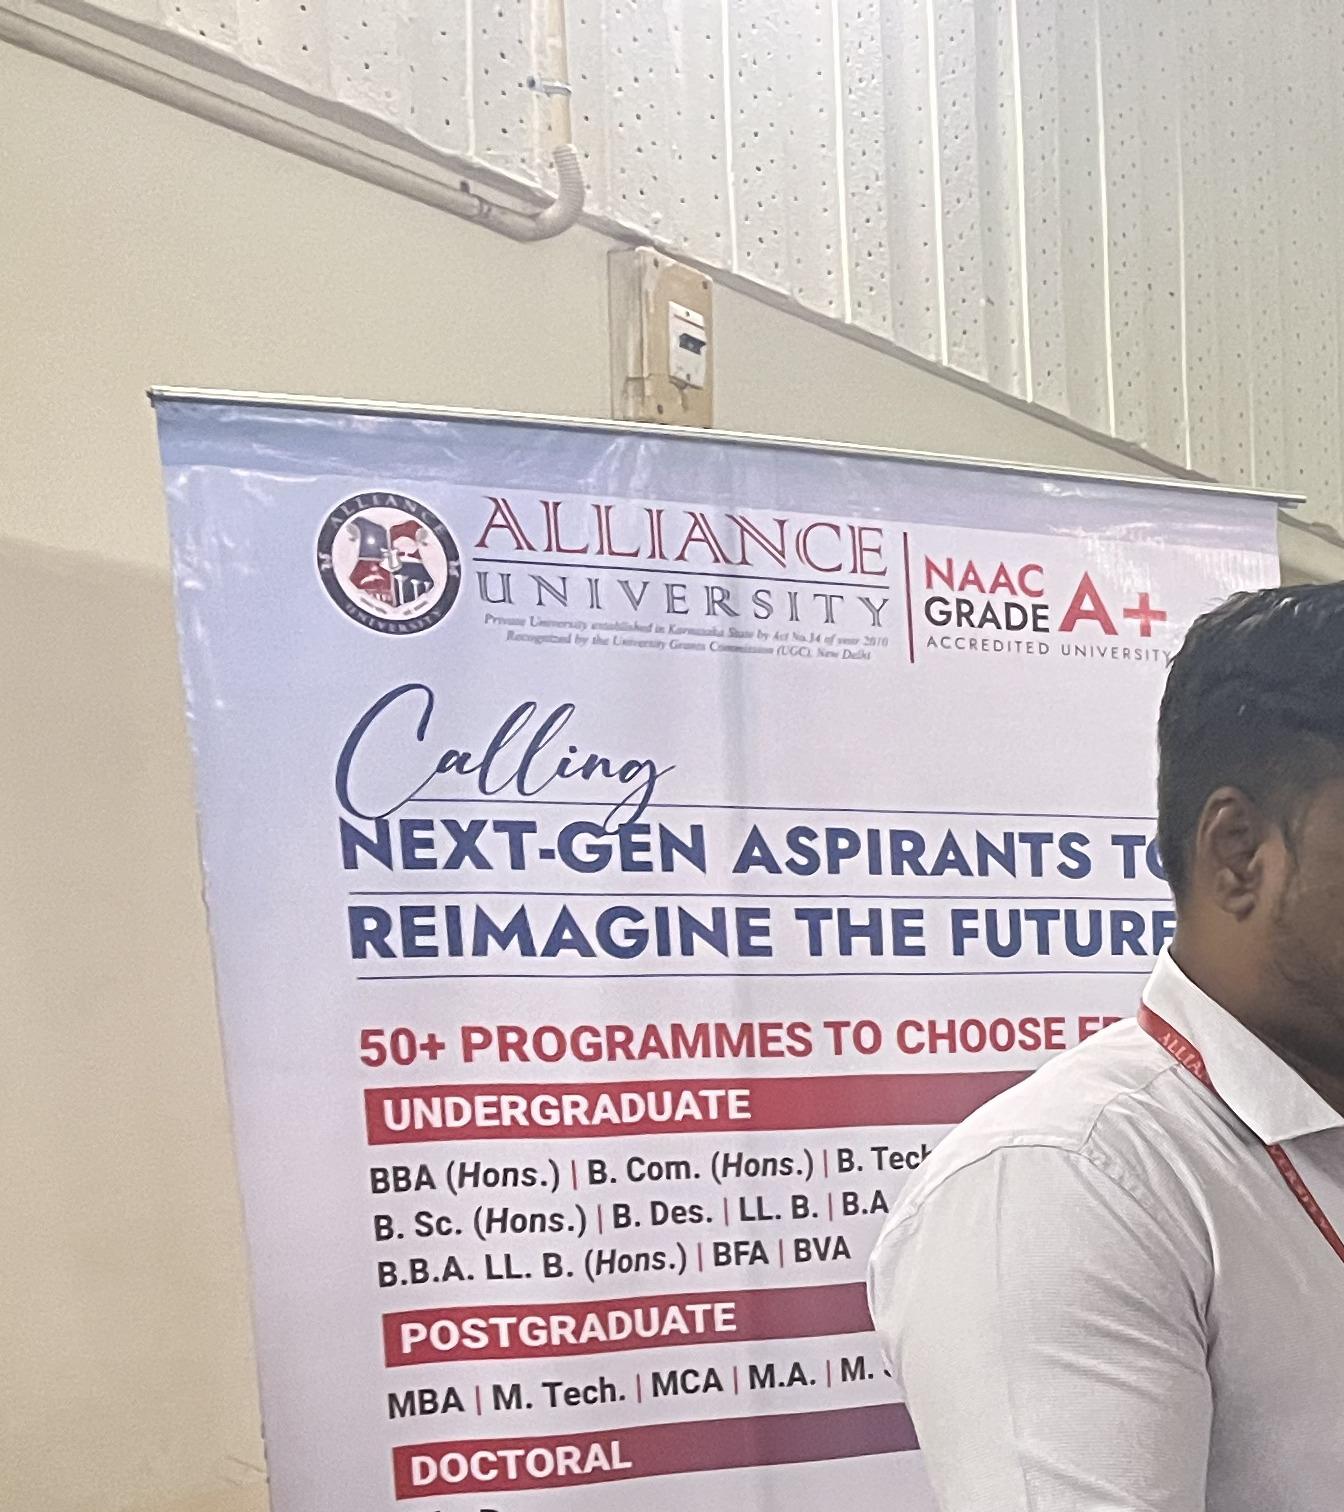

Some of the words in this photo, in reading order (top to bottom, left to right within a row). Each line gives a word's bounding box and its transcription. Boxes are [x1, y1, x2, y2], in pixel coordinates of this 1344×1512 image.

[474, 496, 888, 577] ALLIANCE
[476, 570, 889, 628] UNIVERSITY
[924, 555, 1043, 598] NAAC
[924, 596, 1050, 633] GRADE
[1058, 571, 1167, 637] A+
[927, 635, 1049, 656] ACCREDITED
[1061, 644, 1172, 663] UNIVERSITY
[335, 683, 677, 836] Calling
[339, 816, 707, 876] NEXT-GEN
[732, 824, 1092, 880] ASPIRANTS
[347, 904, 773, 960] REIMAGINE
[794, 906, 926, 957] THE
[951, 908, 1177, 959] FUTURE
[360, 1027, 446, 1068] 50+
[461, 1021, 813, 1063] PROGRAMMES
[824, 1020, 883, 1056] TO
[896, 1017, 1067, 1055] CHOOSE
[383, 1089, 752, 1132] UNDERGRADUATE
[369, 1163, 437, 1194] BBA
[446, 1157, 560, 1197] (Hons.)
[588, 1158, 617, 1186] B.
[626, 1156, 701, 1183] Com.
[711, 1149, 814, 1185] (Hons.)
[837, 1149, 863, 1173] B.
[374, 1213, 405, 1242] B.
[414, 1210, 463, 1238] Sc.
[473, 1204, 587, 1242] (Hons.)
[612, 1202, 642, 1229] B.
[650, 1199, 713, 1226] Des.
[739, 1195, 782, 1222] LL.
[791, 1194, 818, 1219] B.
[377, 1255, 475, 1288] B.B.A.
[484, 1253, 532, 1280] LL.
[542, 1252, 574, 1278] B.
[585, 1242, 687, 1283] (Hons.)
[712, 1240, 770, 1267] BFA
[793, 1236, 852, 1263] BVA
[400, 1302, 737, 1354] POSTGRADUATE
[387, 1387, 465, 1419] MBA
[491, 1382, 534, 1412] M.
[543, 1376, 627, 1408] Tech.
[651, 1367, 725, 1398] MCA
[748, 1361, 817, 1390] M.A.
[840, 1355, 875, 1382] M.
[411, 1441, 633, 1486] DOCTORAL
